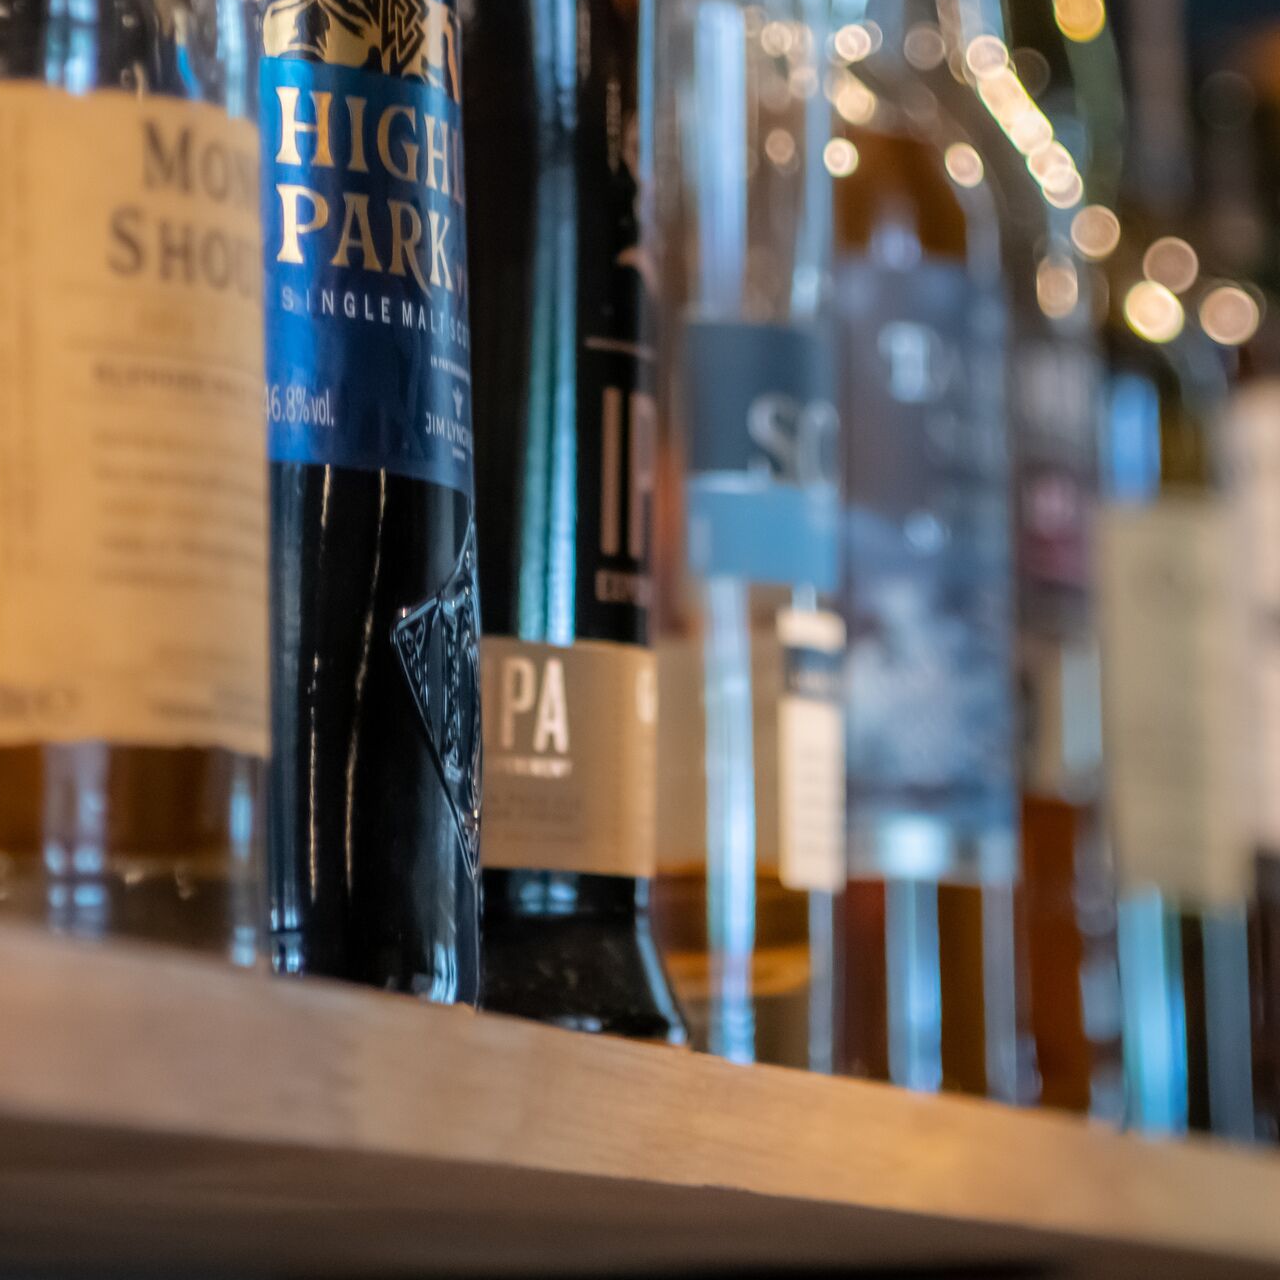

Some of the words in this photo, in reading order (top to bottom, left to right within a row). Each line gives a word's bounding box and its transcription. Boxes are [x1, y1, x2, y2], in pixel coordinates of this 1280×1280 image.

[275, 183, 454, 300] PARK
[281, 285, 391, 324] SINGLE
[401, 300, 447, 336] MALT
[425, 411, 445, 439] JIM
